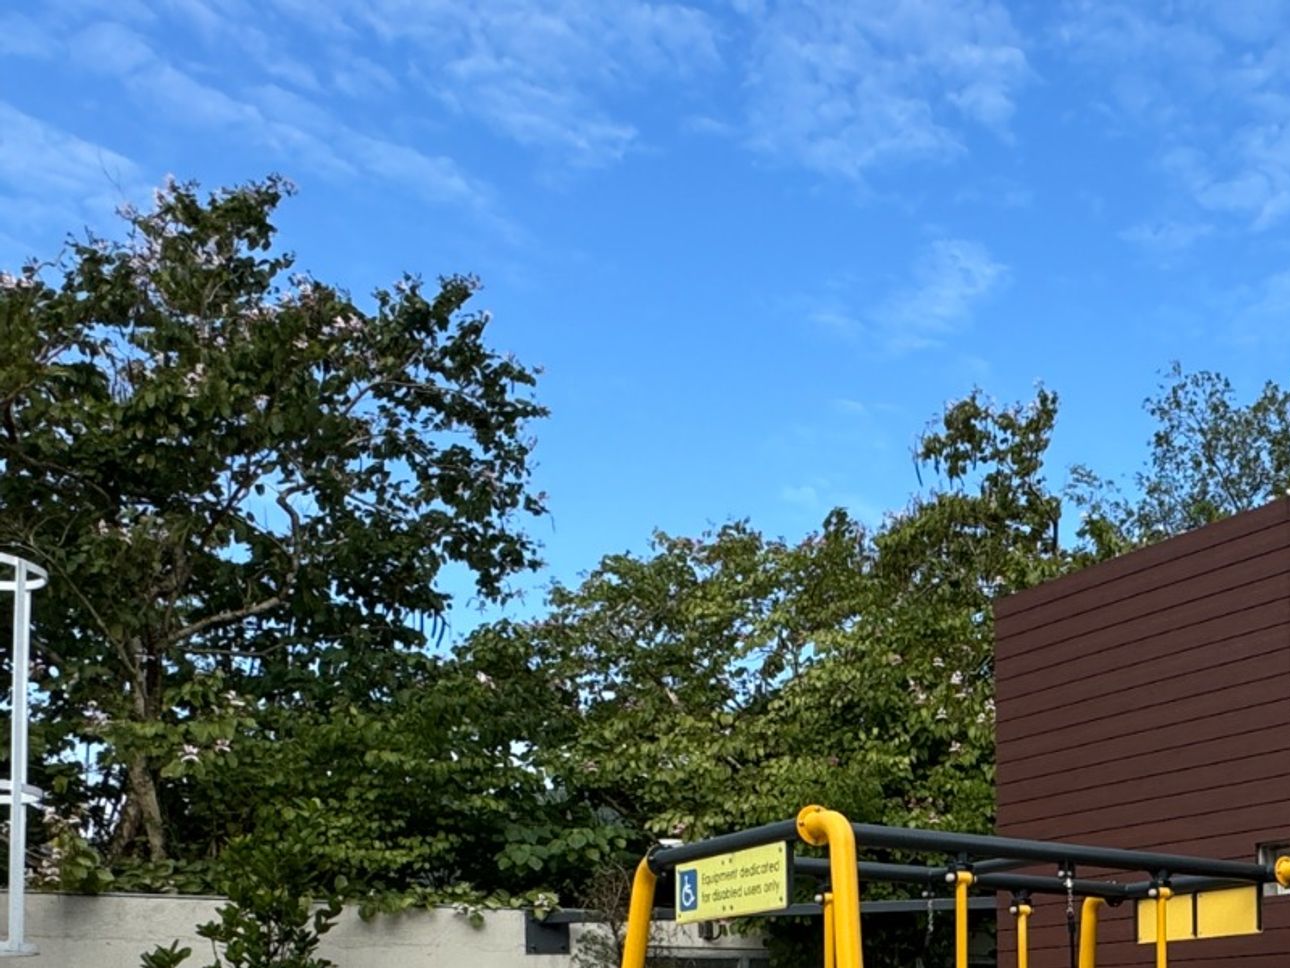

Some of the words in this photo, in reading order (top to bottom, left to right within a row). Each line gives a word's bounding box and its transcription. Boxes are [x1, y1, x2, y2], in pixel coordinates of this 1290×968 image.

[701, 869, 738, 885] Equipment
[740, 861, 780, 879] dedicated
[701, 892, 712, 903] for
[712, 884, 742, 901] disabled
[744, 884, 762, 896] users
[763, 879, 780, 895] only
